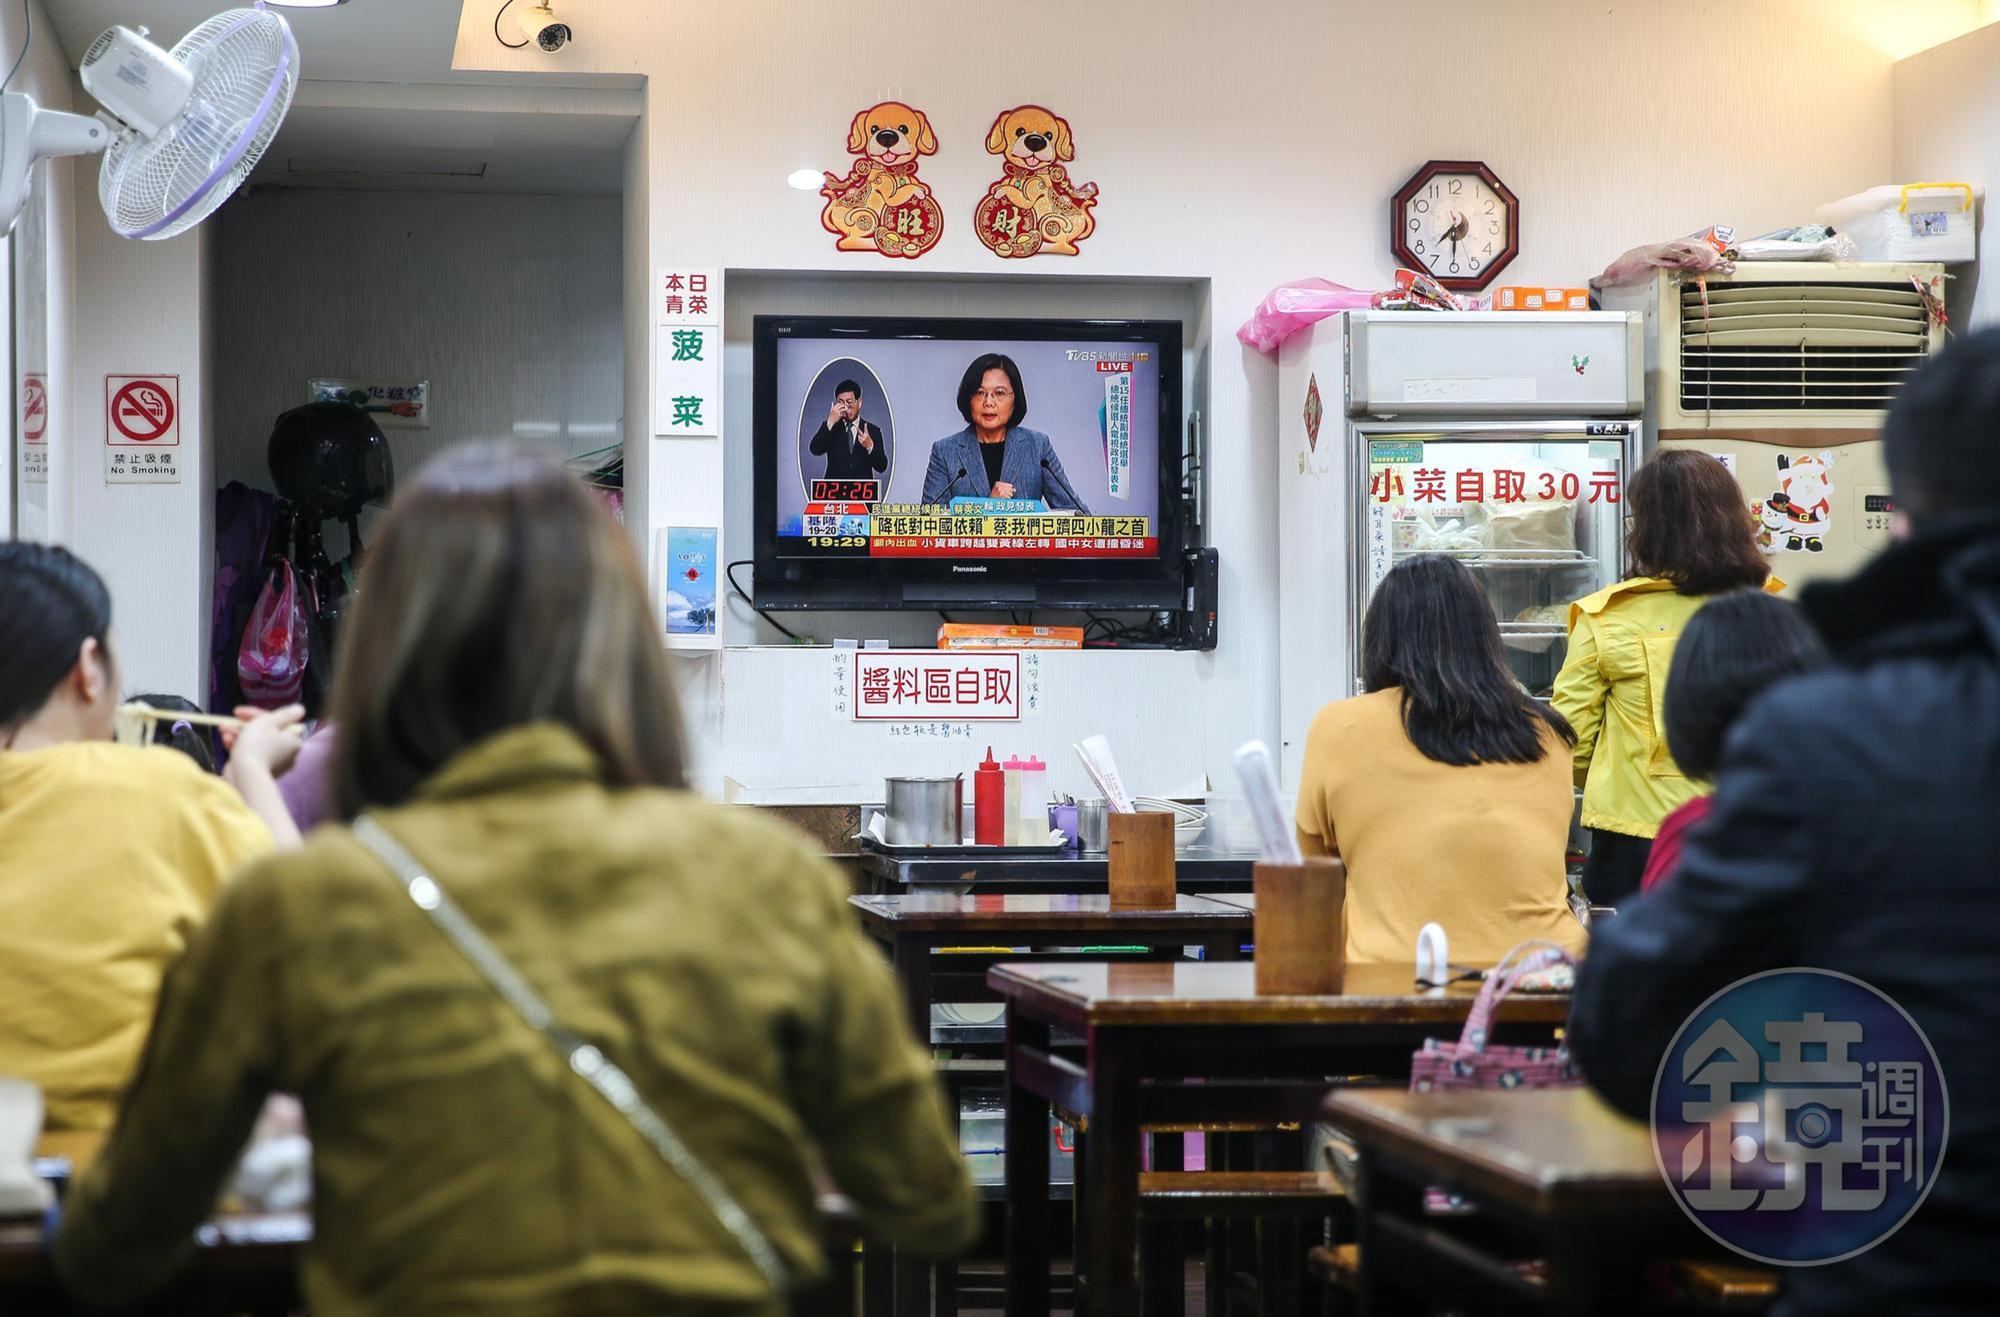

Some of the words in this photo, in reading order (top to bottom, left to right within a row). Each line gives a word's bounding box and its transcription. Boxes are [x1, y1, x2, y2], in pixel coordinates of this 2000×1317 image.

[1429, 184, 1439, 199] 11
[1448, 179, 1462, 195] 12
[1413, 198, 1429, 213] 10
[1484, 200, 1495, 215] 2
[896, 207, 925, 236] 旺
[991, 207, 1022, 240] 財
[1409, 218, 1420, 233] 9
[1489, 220, 1500, 235] 3
[1415, 239, 1425, 254] 8
[1482, 241, 1492, 256] 4
[1430, 254, 1440, 268] 7
[1449, 258, 1460, 273] 6
[1468, 256, 1480, 270] 5
[665, 273, 707, 292] 本日
[1065, 349, 1097, 360] TVBS
[1101, 362, 1128, 371] LIVE
[671, 329, 704, 428] 菠菜
[1119, 376, 1129, 467] 第15任總統副總統選舉
[1110, 385, 1119, 493] 總統候選人電視政見發表會
[114, 453, 173, 464] 禁止吸煙
[111, 466, 125, 474] No
[131, 466, 176, 475] Smoking
[814, 482, 874, 500] 02:26
[823, 503, 849, 515] 台北
[807, 515, 837, 526] 基隆
[807, 536, 867, 548] 19:29
[953, 565, 987, 573] Panasonic
[863, 667, 1012, 705] 醬料區自取
